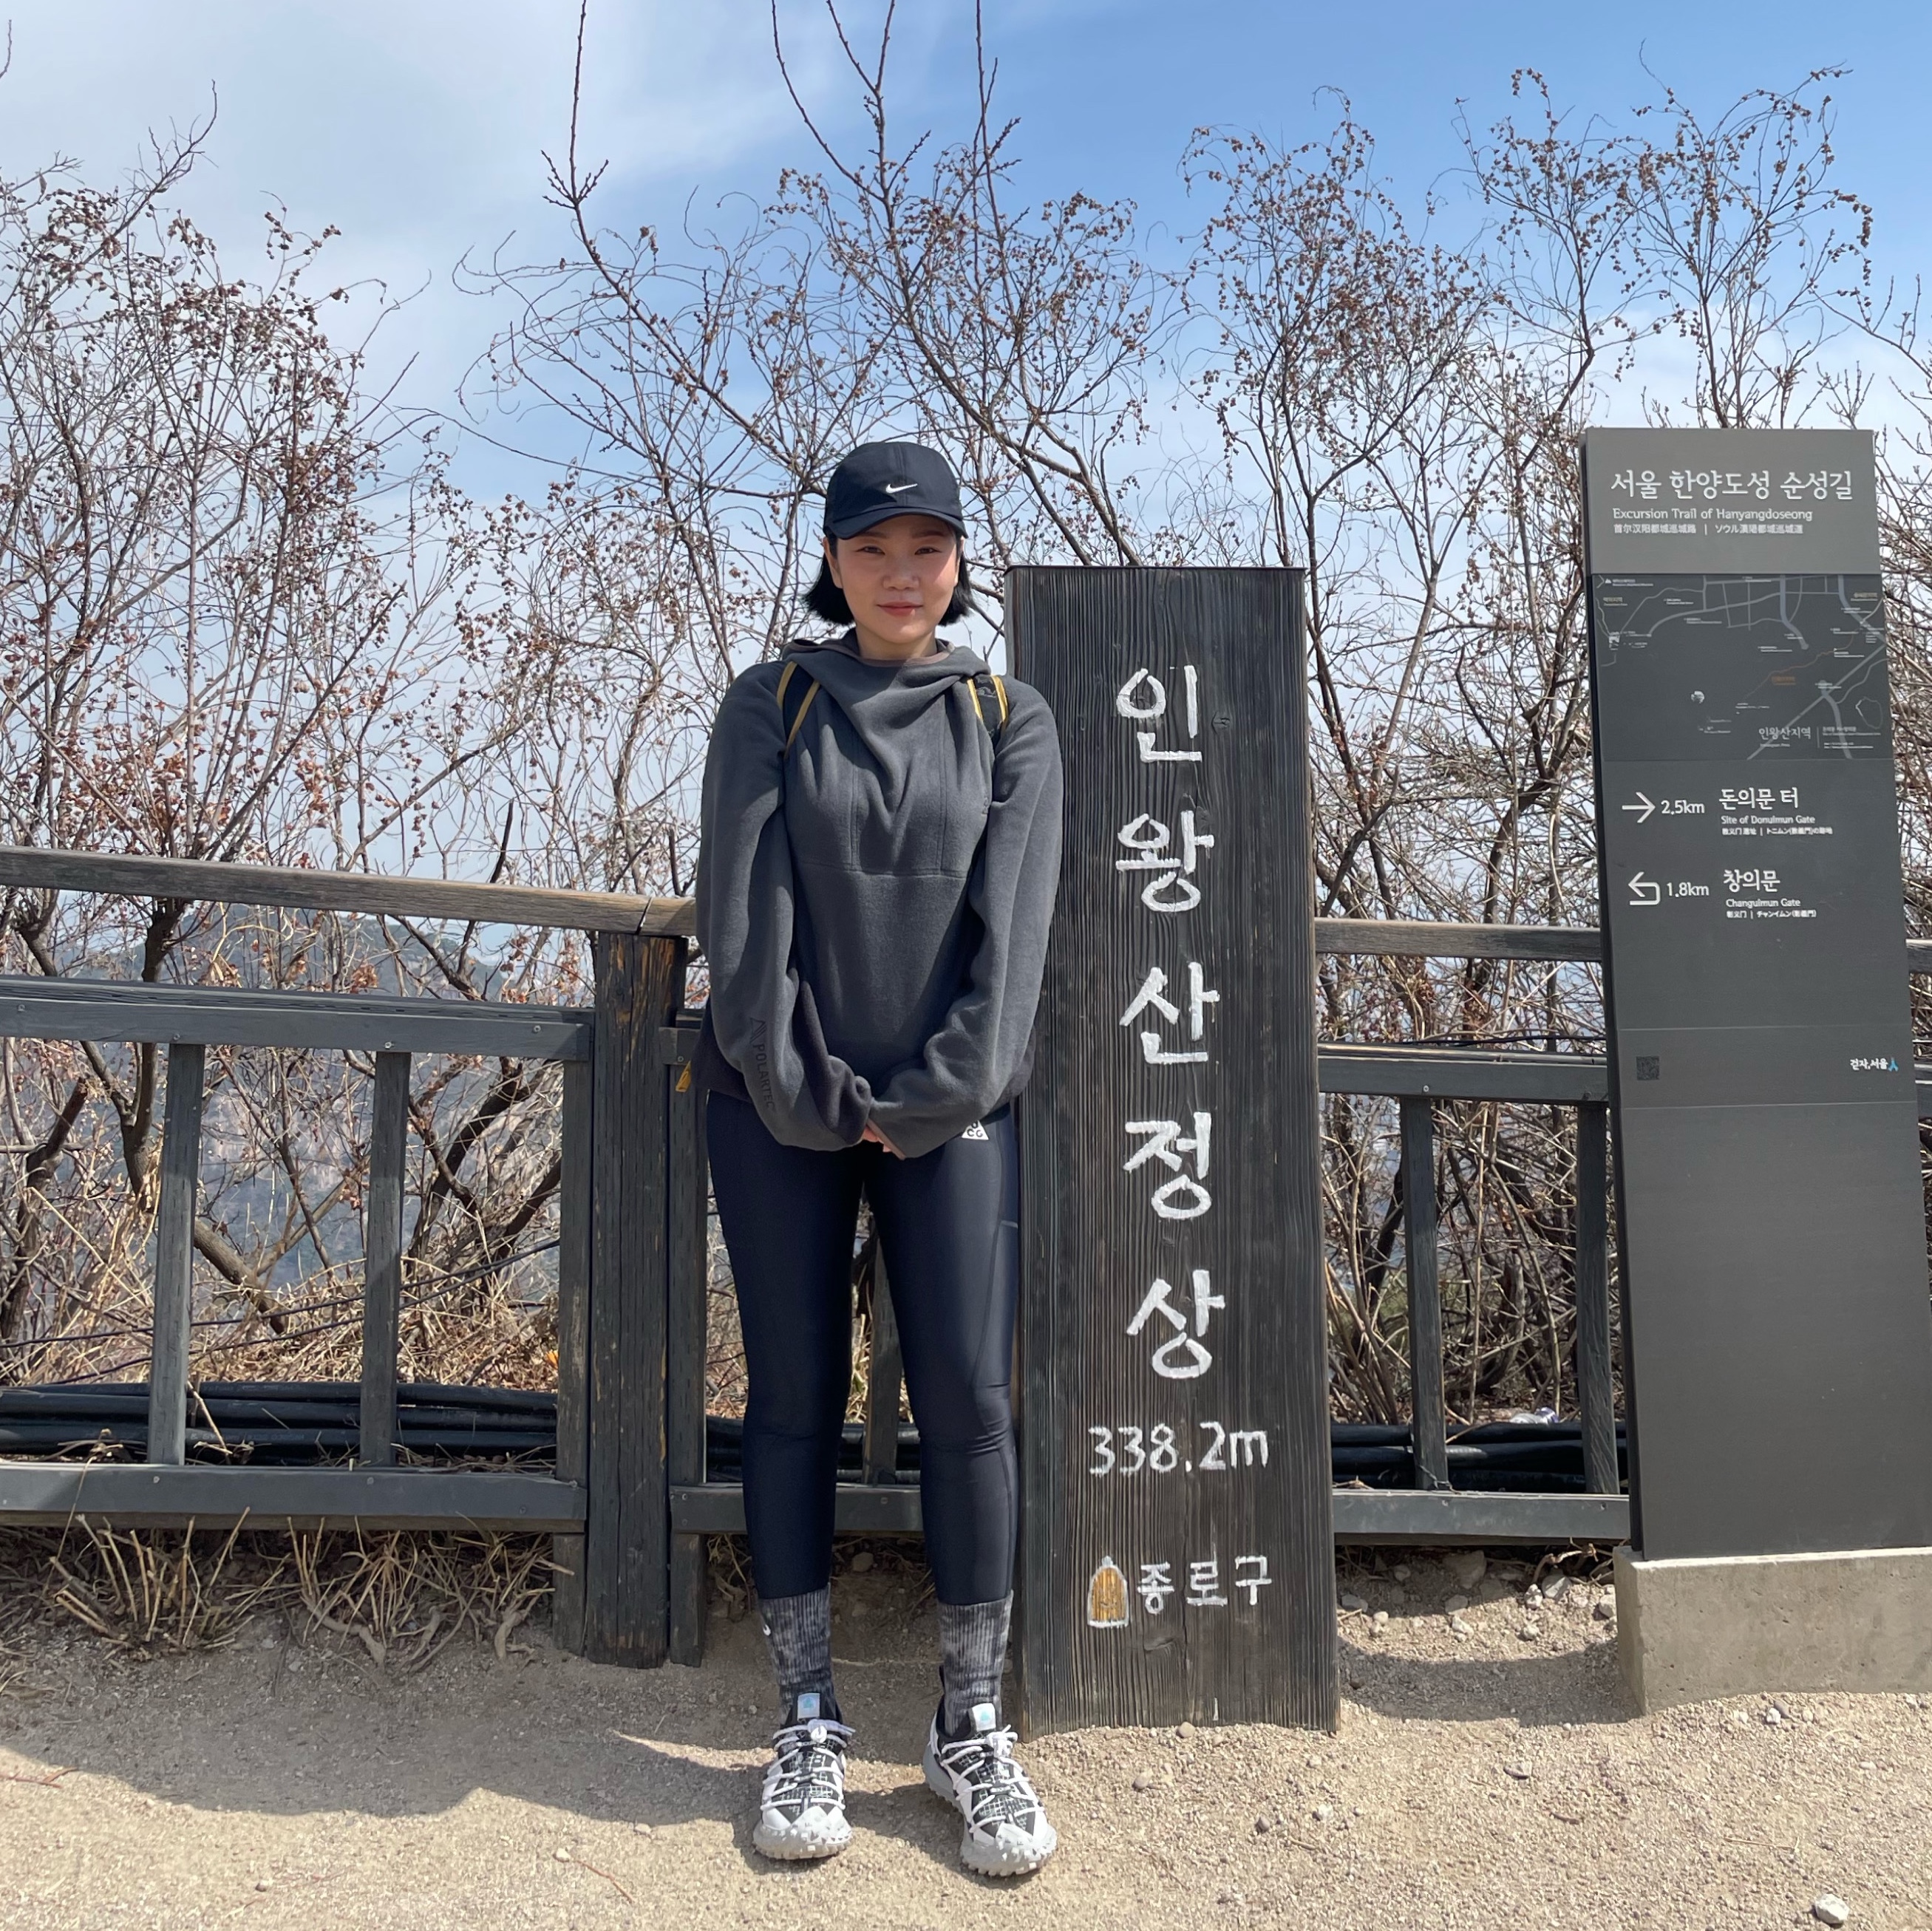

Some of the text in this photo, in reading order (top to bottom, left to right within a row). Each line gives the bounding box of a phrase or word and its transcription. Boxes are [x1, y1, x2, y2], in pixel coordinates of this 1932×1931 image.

[1611, 470, 1853, 500] 서울 한양도성 순성길
[1613, 508, 1812, 521] Excursion Trail of Hanyangdoseong
[1758, 726, 1812, 740] 인왕산지역
[1661, 800, 1705, 815] 2.5km
[1718, 787, 1798, 811] 돈의문 터
[1721, 815, 1737, 823] Site
[1739, 815, 1749, 823] of
[1795, 814, 1816, 823] Gate
[1667, 882, 1710, 898] 1.8km
[1723, 868, 1780, 893] 창의문
[1726, 898, 1801, 909] Changuimun Gate
[1116, 665, 1225, 1378] 인왕산정상
[1850, 1058, 1888, 1071] 걷자,서울
[753, 1043, 775, 1109] POLARTEC
[1089, 1421, 1268, 1477] 338.2m
[1137, 1551, 1273, 1615] 종로구
